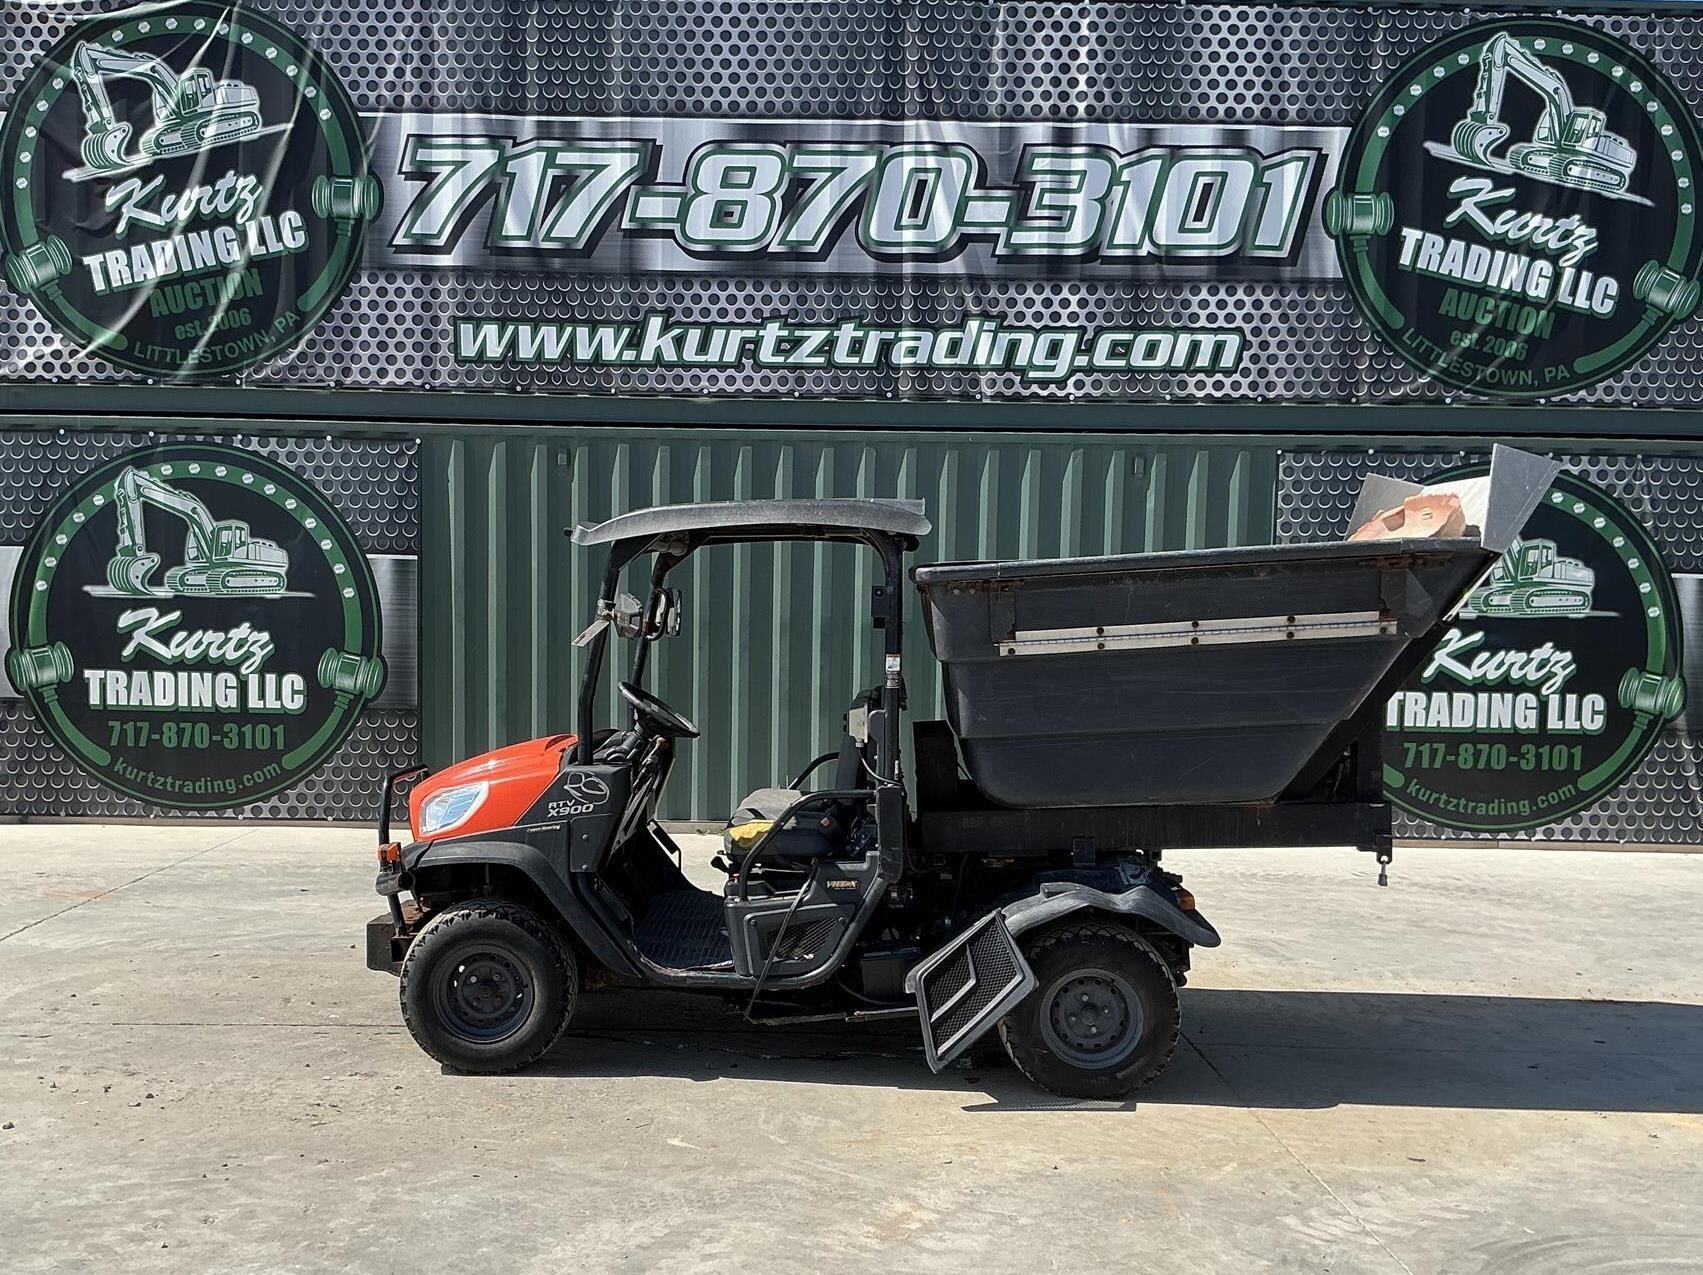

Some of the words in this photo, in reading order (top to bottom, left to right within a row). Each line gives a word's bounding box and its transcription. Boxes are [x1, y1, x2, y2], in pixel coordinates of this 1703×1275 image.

[105, 170, 262, 240] Kurtz
[394, 135, 1323, 263] 717-870-3101
[1443, 175, 1598, 267] Kurtz
[83, 225, 241, 295] TRADING
[246, 210, 309, 256] LLC
[1399, 227, 1554, 301] TRADING
[1555, 266, 1619, 319] LLC
[150, 267, 264, 319] AUCTION
[1438, 287, 1556, 340] AUCTION
[133, 328, 277, 365] LITTLESTOWN,
[274, 310, 301, 334] PA
[455, 313, 1244, 382] www.kurtztrading.com
[1401, 327, 1539, 388] LITTLESTOWN,
[1543, 364, 1571, 383] PA
[117, 607, 275, 675] Kurtz
[1421, 628, 1577, 697] Kurtz
[84, 669, 241, 712] TRADING
[247, 672, 308, 715] LLC
[1545, 693, 1607, 735] LLC
[107, 720, 287, 751] 717-870-3101
[1402, 742, 1583, 772] 717-870-3101
[112, 757, 282, 795] kurtztrading.com
[1405, 778, 1577, 816] kurtztrading.com
[547, 803, 595, 818] X900
[548, 799, 576, 809] RTV
